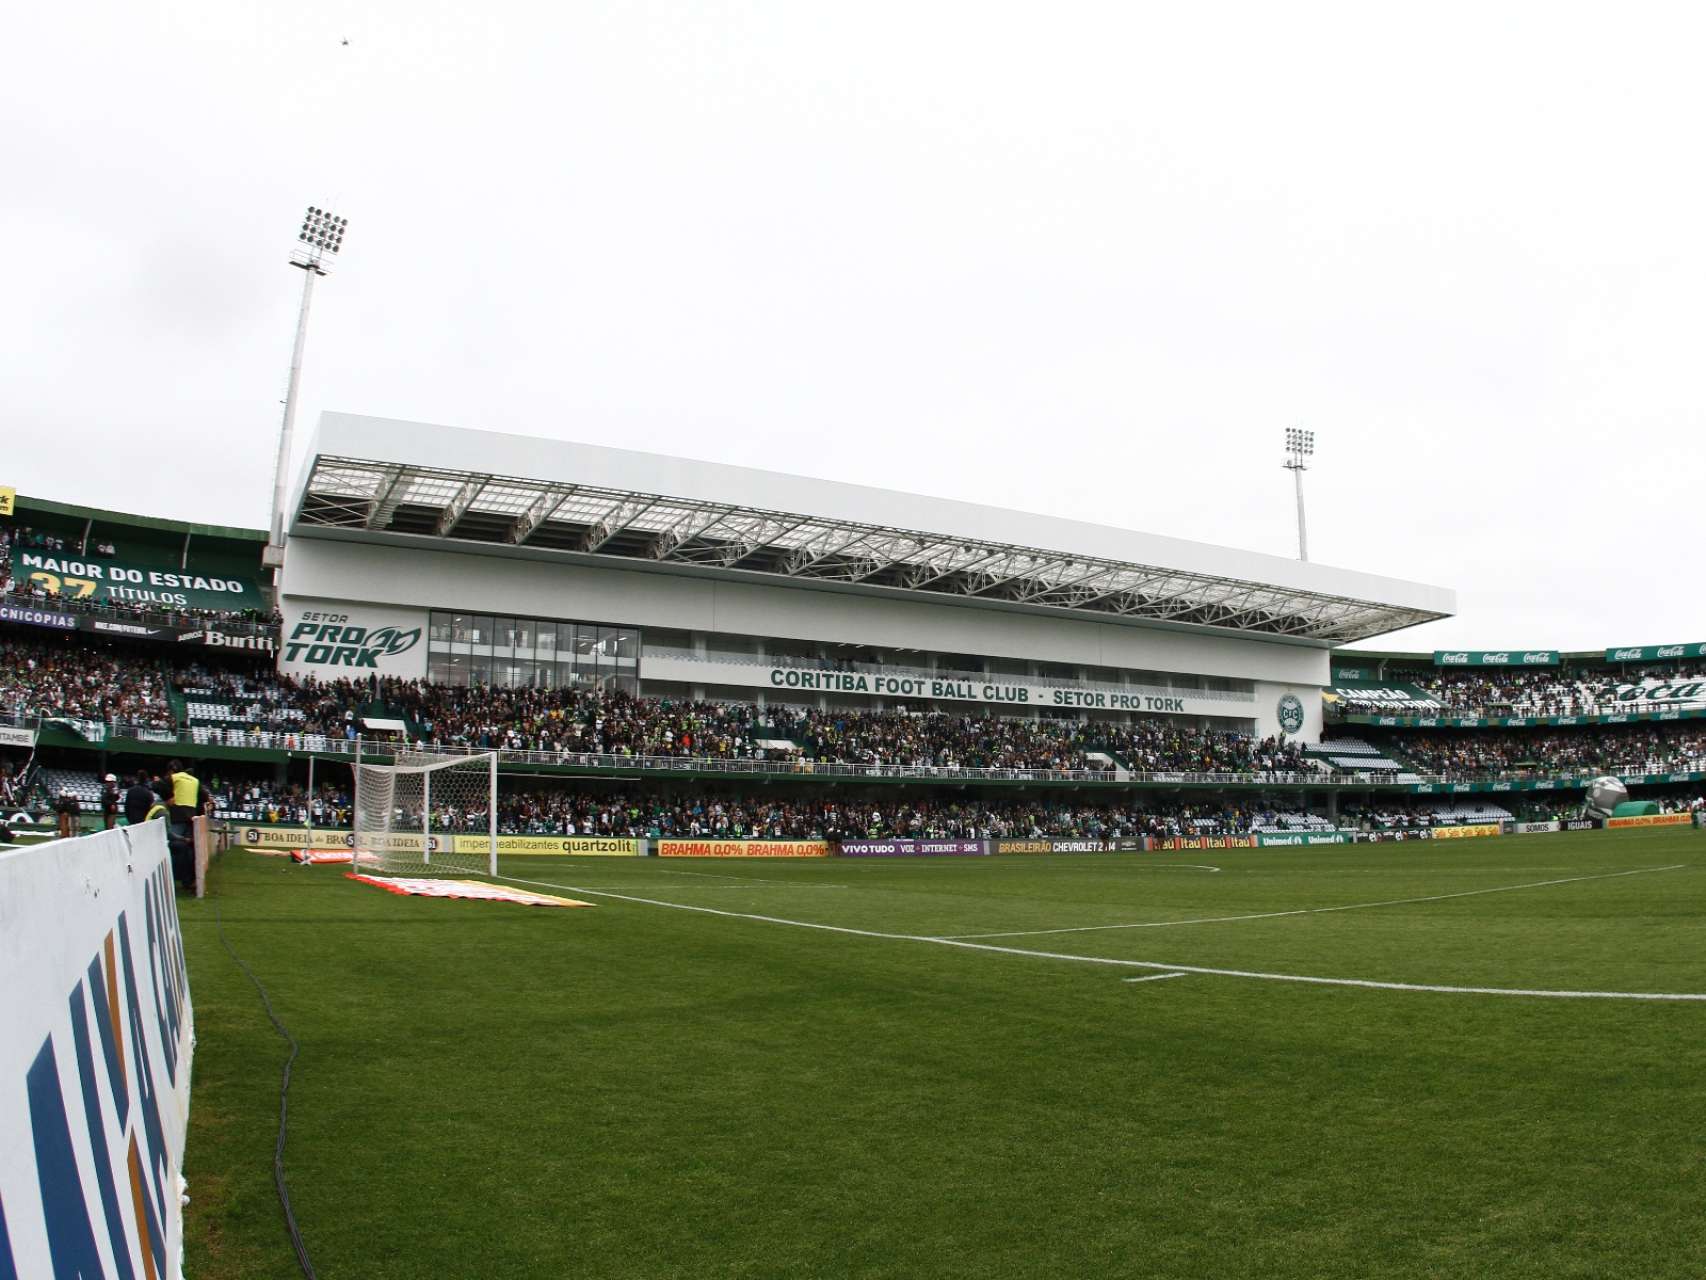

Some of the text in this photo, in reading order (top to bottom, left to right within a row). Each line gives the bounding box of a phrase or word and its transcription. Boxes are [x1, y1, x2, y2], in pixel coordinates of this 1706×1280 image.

[22, 553, 244, 593] MAIOR DO ESTADO
[30, 572, 97, 599] 37
[106, 585, 188, 606] TÍTULOS
[0, 608, 75, 627] CNICOPIAS
[301, 611, 349, 623] SETOR
[290, 622, 368, 645] PRO
[285, 642, 385, 668] TORK
[770, 669, 869, 692] CORITIBA
[875, 677, 925, 695] FOOT
[931, 682, 977, 699] BALL
[982, 685, 1029, 702] CLUB
[1053, 690, 1106, 707] SETOR
[1110, 694, 1140, 709] PRO
[1145, 697, 1184, 712] TORK
[1526, 823, 1549, 833] SOMOS
[1567, 820, 1592, 830] IGUAIS
[264, 832, 285, 843] BOA
[1263, 834, 1335, 846] Unimed Unimed
[562, 838, 631, 854] quartzolit
[661, 843, 826, 857] BRAHMA 0,0% BRAHMA 0,0%
[842, 843, 978, 853] VIVO TUDO VOZ INTERNET SMS
[1052, 842, 1097, 852] CHEVROLET
